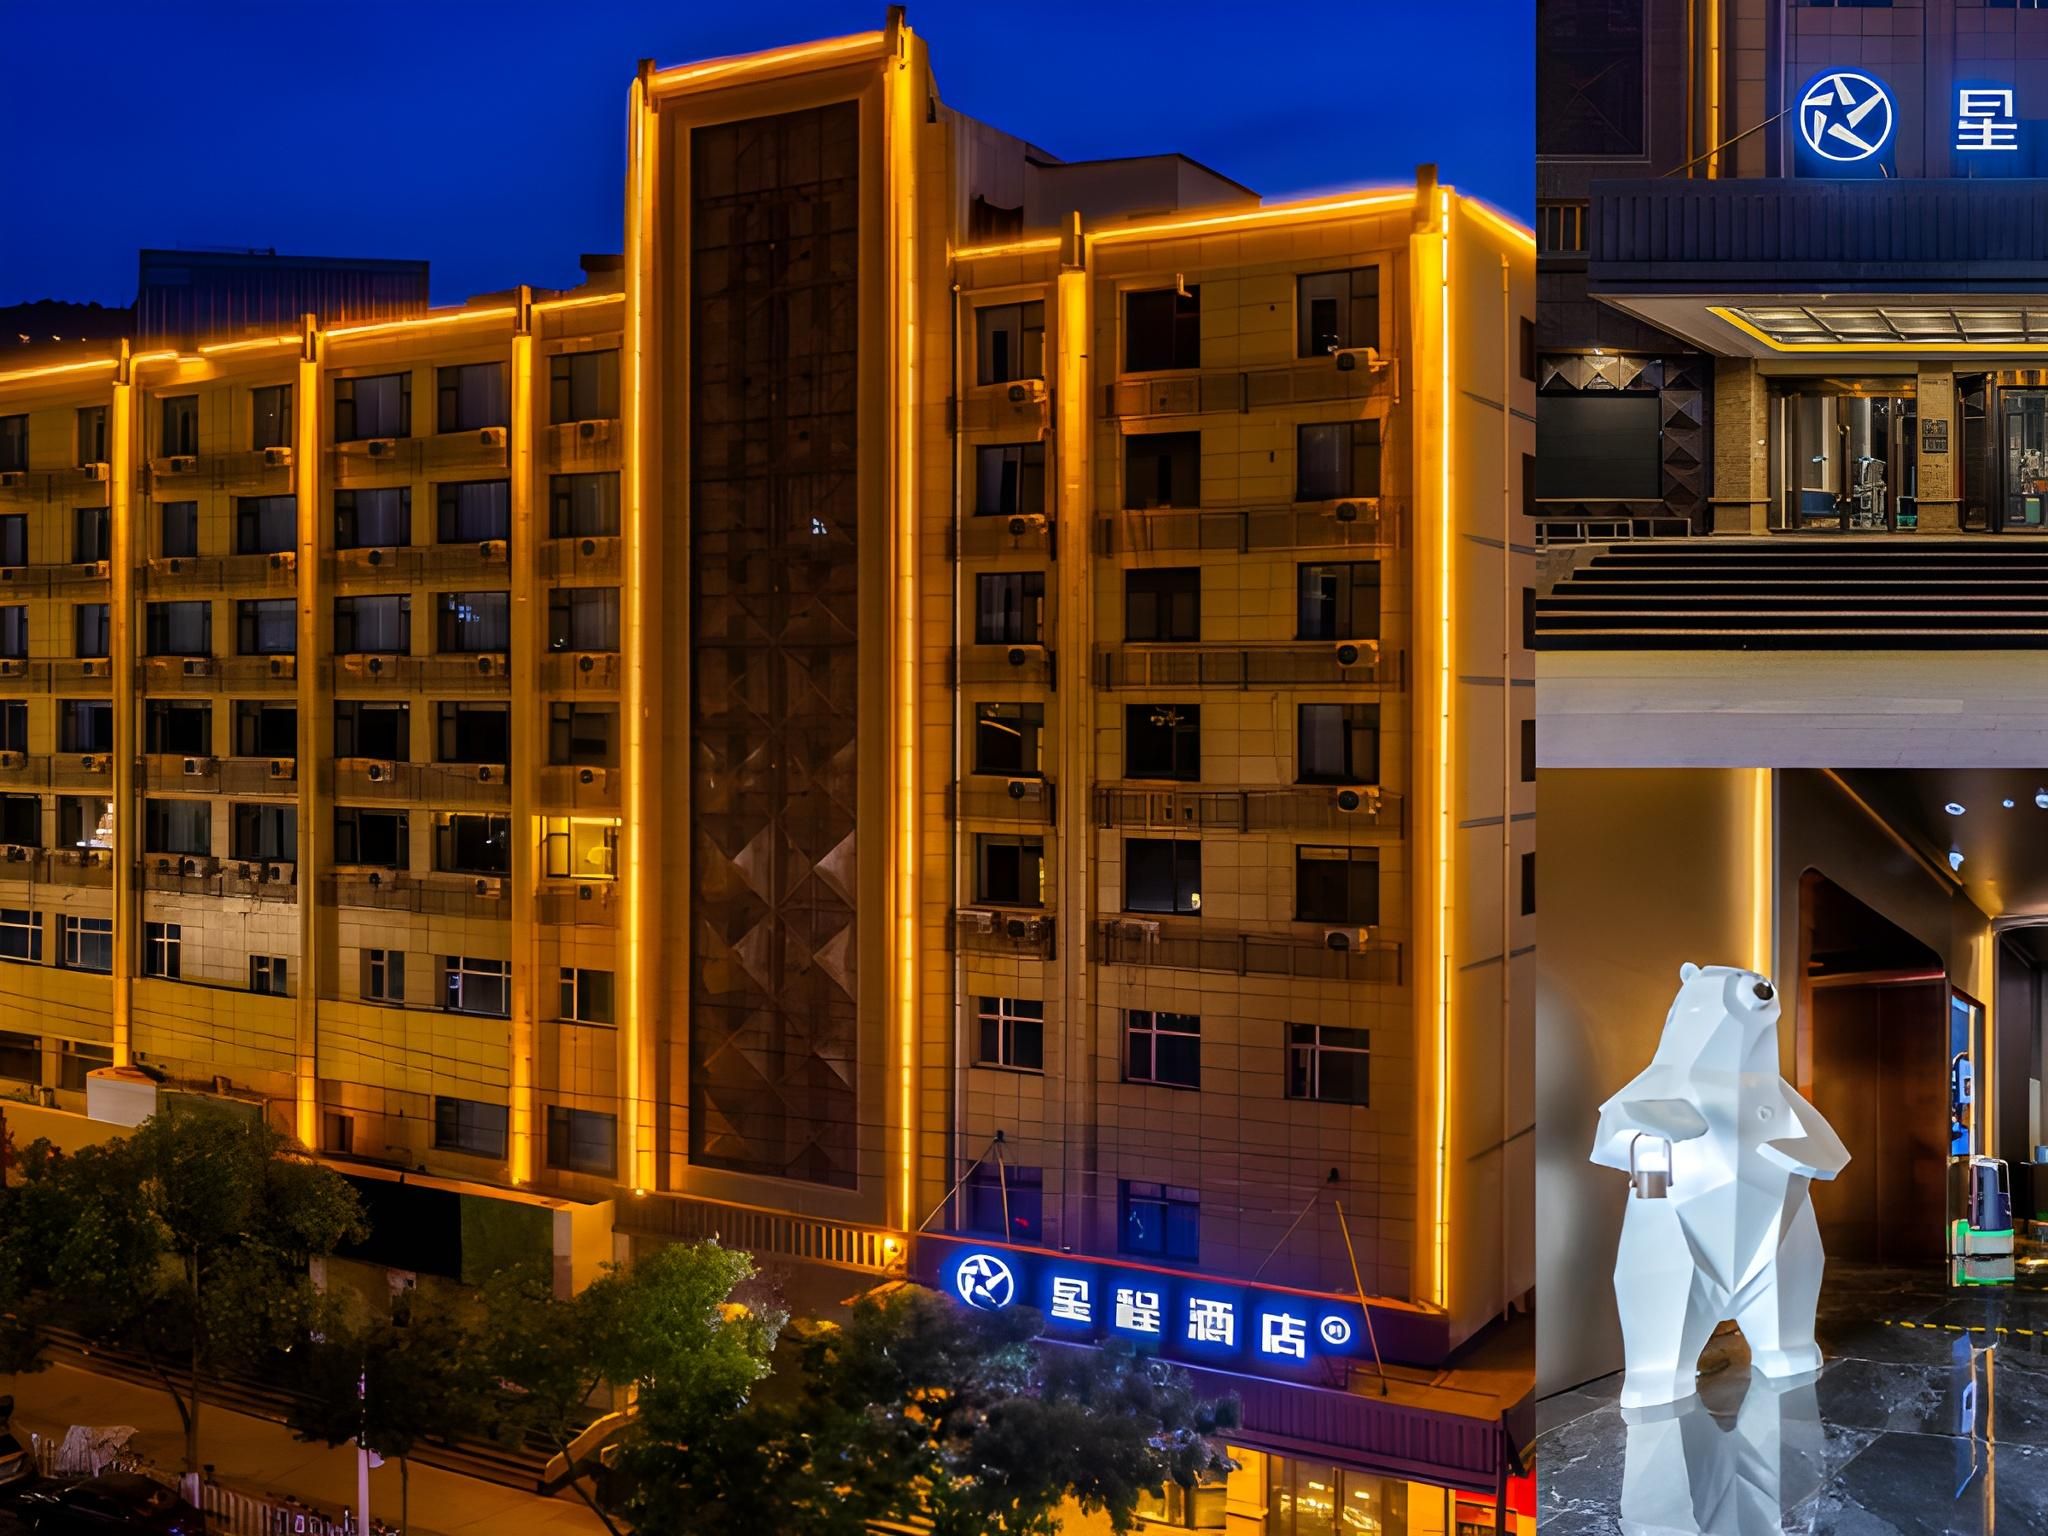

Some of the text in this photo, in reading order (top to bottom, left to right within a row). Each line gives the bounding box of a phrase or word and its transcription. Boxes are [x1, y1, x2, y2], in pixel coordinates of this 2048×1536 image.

[1956, 89, 2018, 150] 星
[1050, 1276, 1307, 1358] 星程酒店
